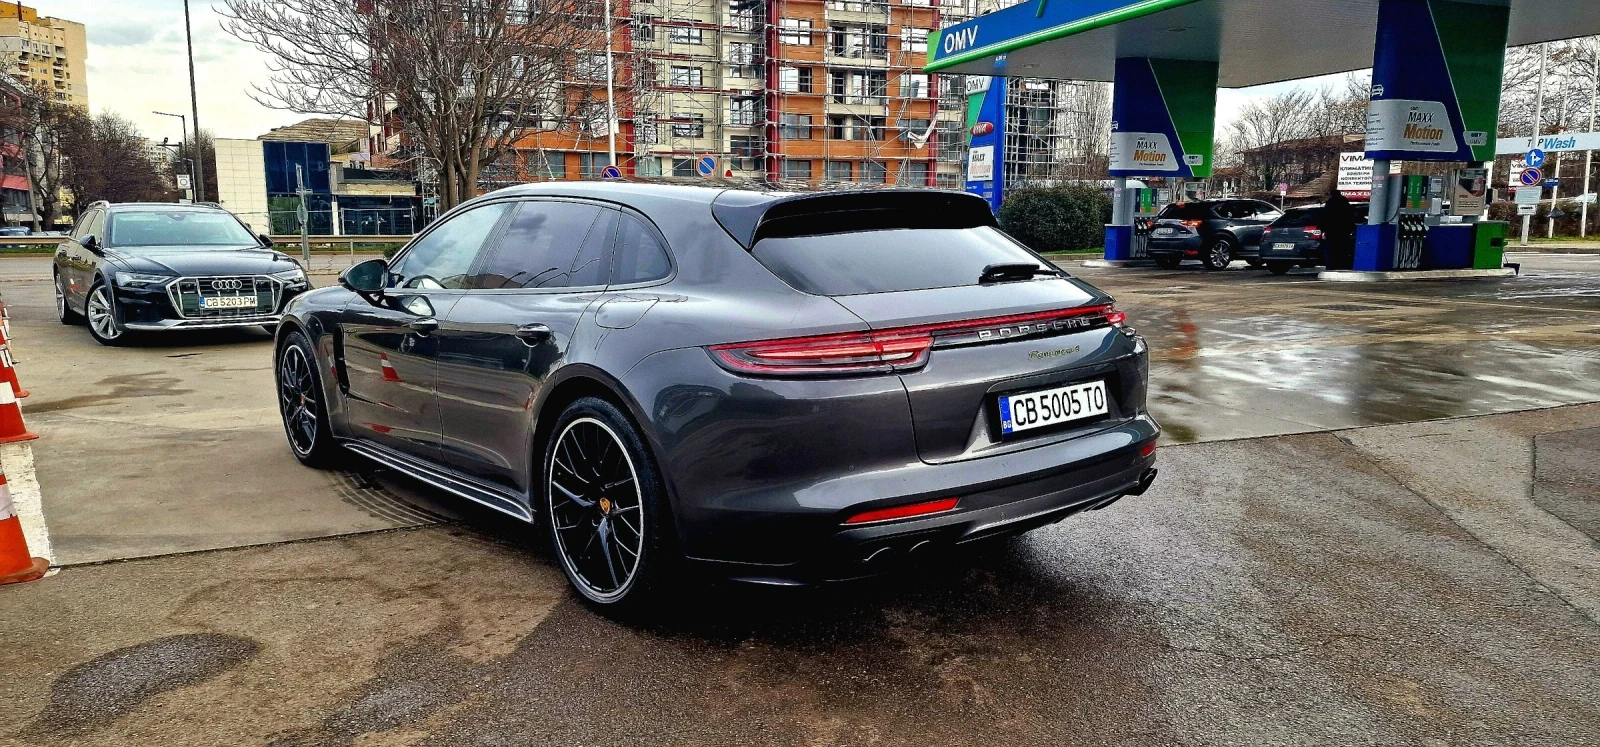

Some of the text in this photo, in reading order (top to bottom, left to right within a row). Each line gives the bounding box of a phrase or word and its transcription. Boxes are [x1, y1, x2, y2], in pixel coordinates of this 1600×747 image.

[944, 24, 979, 54] OMV
[966, 77, 985, 92] OMV
[1407, 111, 1435, 123] MAXX
[1403, 123, 1444, 140] Motion
[1136, 141, 1158, 149] MAXX
[1543, 136, 1576, 149] Wash
[1133, 149, 1167, 162] Motion
[206, 298, 219, 307] CB
[219, 297, 243, 307] 5203
[243, 296, 256, 305] PM
[978, 317, 1091, 340] PORSCHE
[1013, 397, 1038, 426] CB
[1040, 389, 1081, 421] 5005
[1003, 420, 1012, 429] BG
